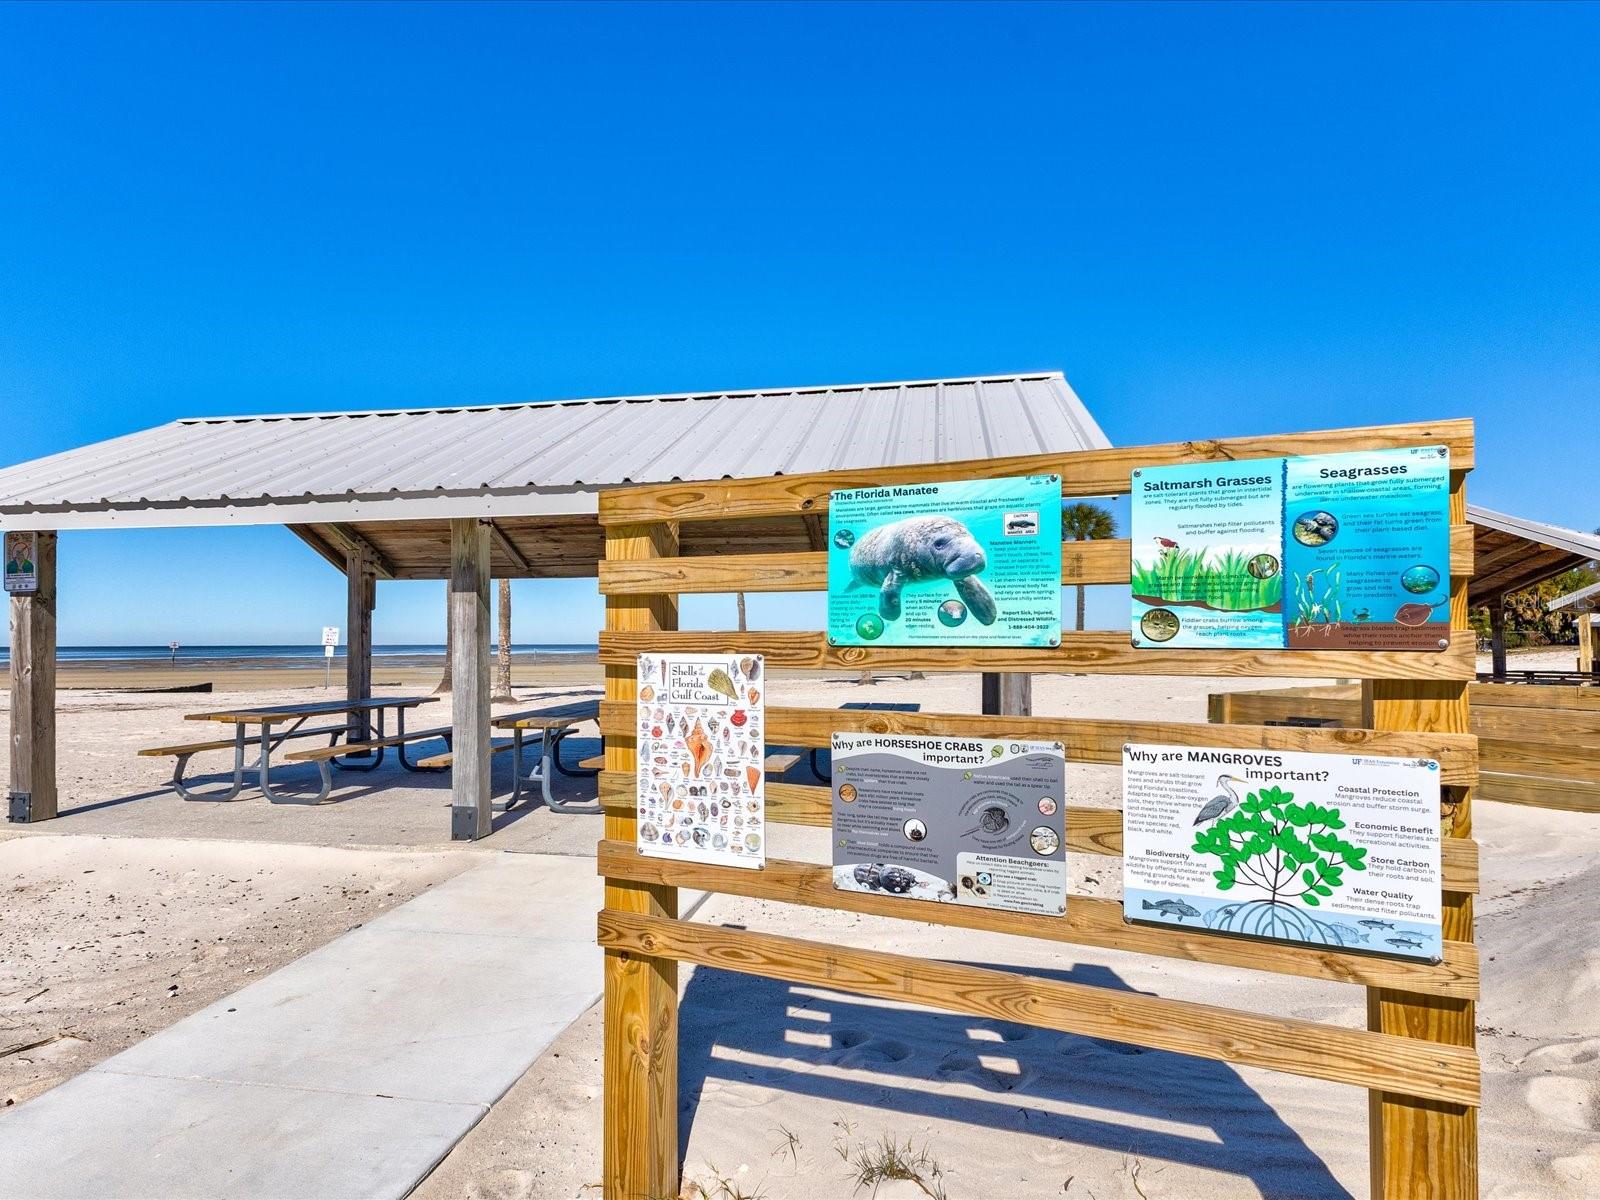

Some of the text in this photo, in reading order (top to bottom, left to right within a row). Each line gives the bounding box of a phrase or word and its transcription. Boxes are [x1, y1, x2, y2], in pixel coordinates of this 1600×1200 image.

[1320, 465, 1407, 479] Seagrasses
[1144, 477, 1271, 491] Saltmarsh Grasses
[855, 490, 890, 499] Florida
[893, 487, 938, 496] Manatee
[672, 666, 697, 676] Shells
[672, 679, 703, 688] Florida
[672, 690, 719, 700] Gulf Coast
[832, 741, 854, 750] Why
[875, 739, 941, 750] HORSESHOE
[945, 742, 982, 752] CRABS
[923, 753, 984, 764] important?
[1129, 752, 1282, 766] Why are MANGROVES
[1246, 768, 1329, 782] important?
[1373, 788, 1419, 797] Protection
[1355, 822, 1433, 834] Economic Benefit
[1146, 850, 1189, 860] Biodiversity
[1009, 857, 1049, 867] Beachgoers:
[1371, 857, 1429, 868] Store Carbon
[1353, 888, 1413, 901] Water Quality
[1399, 911, 1436, 919] pollutants.
